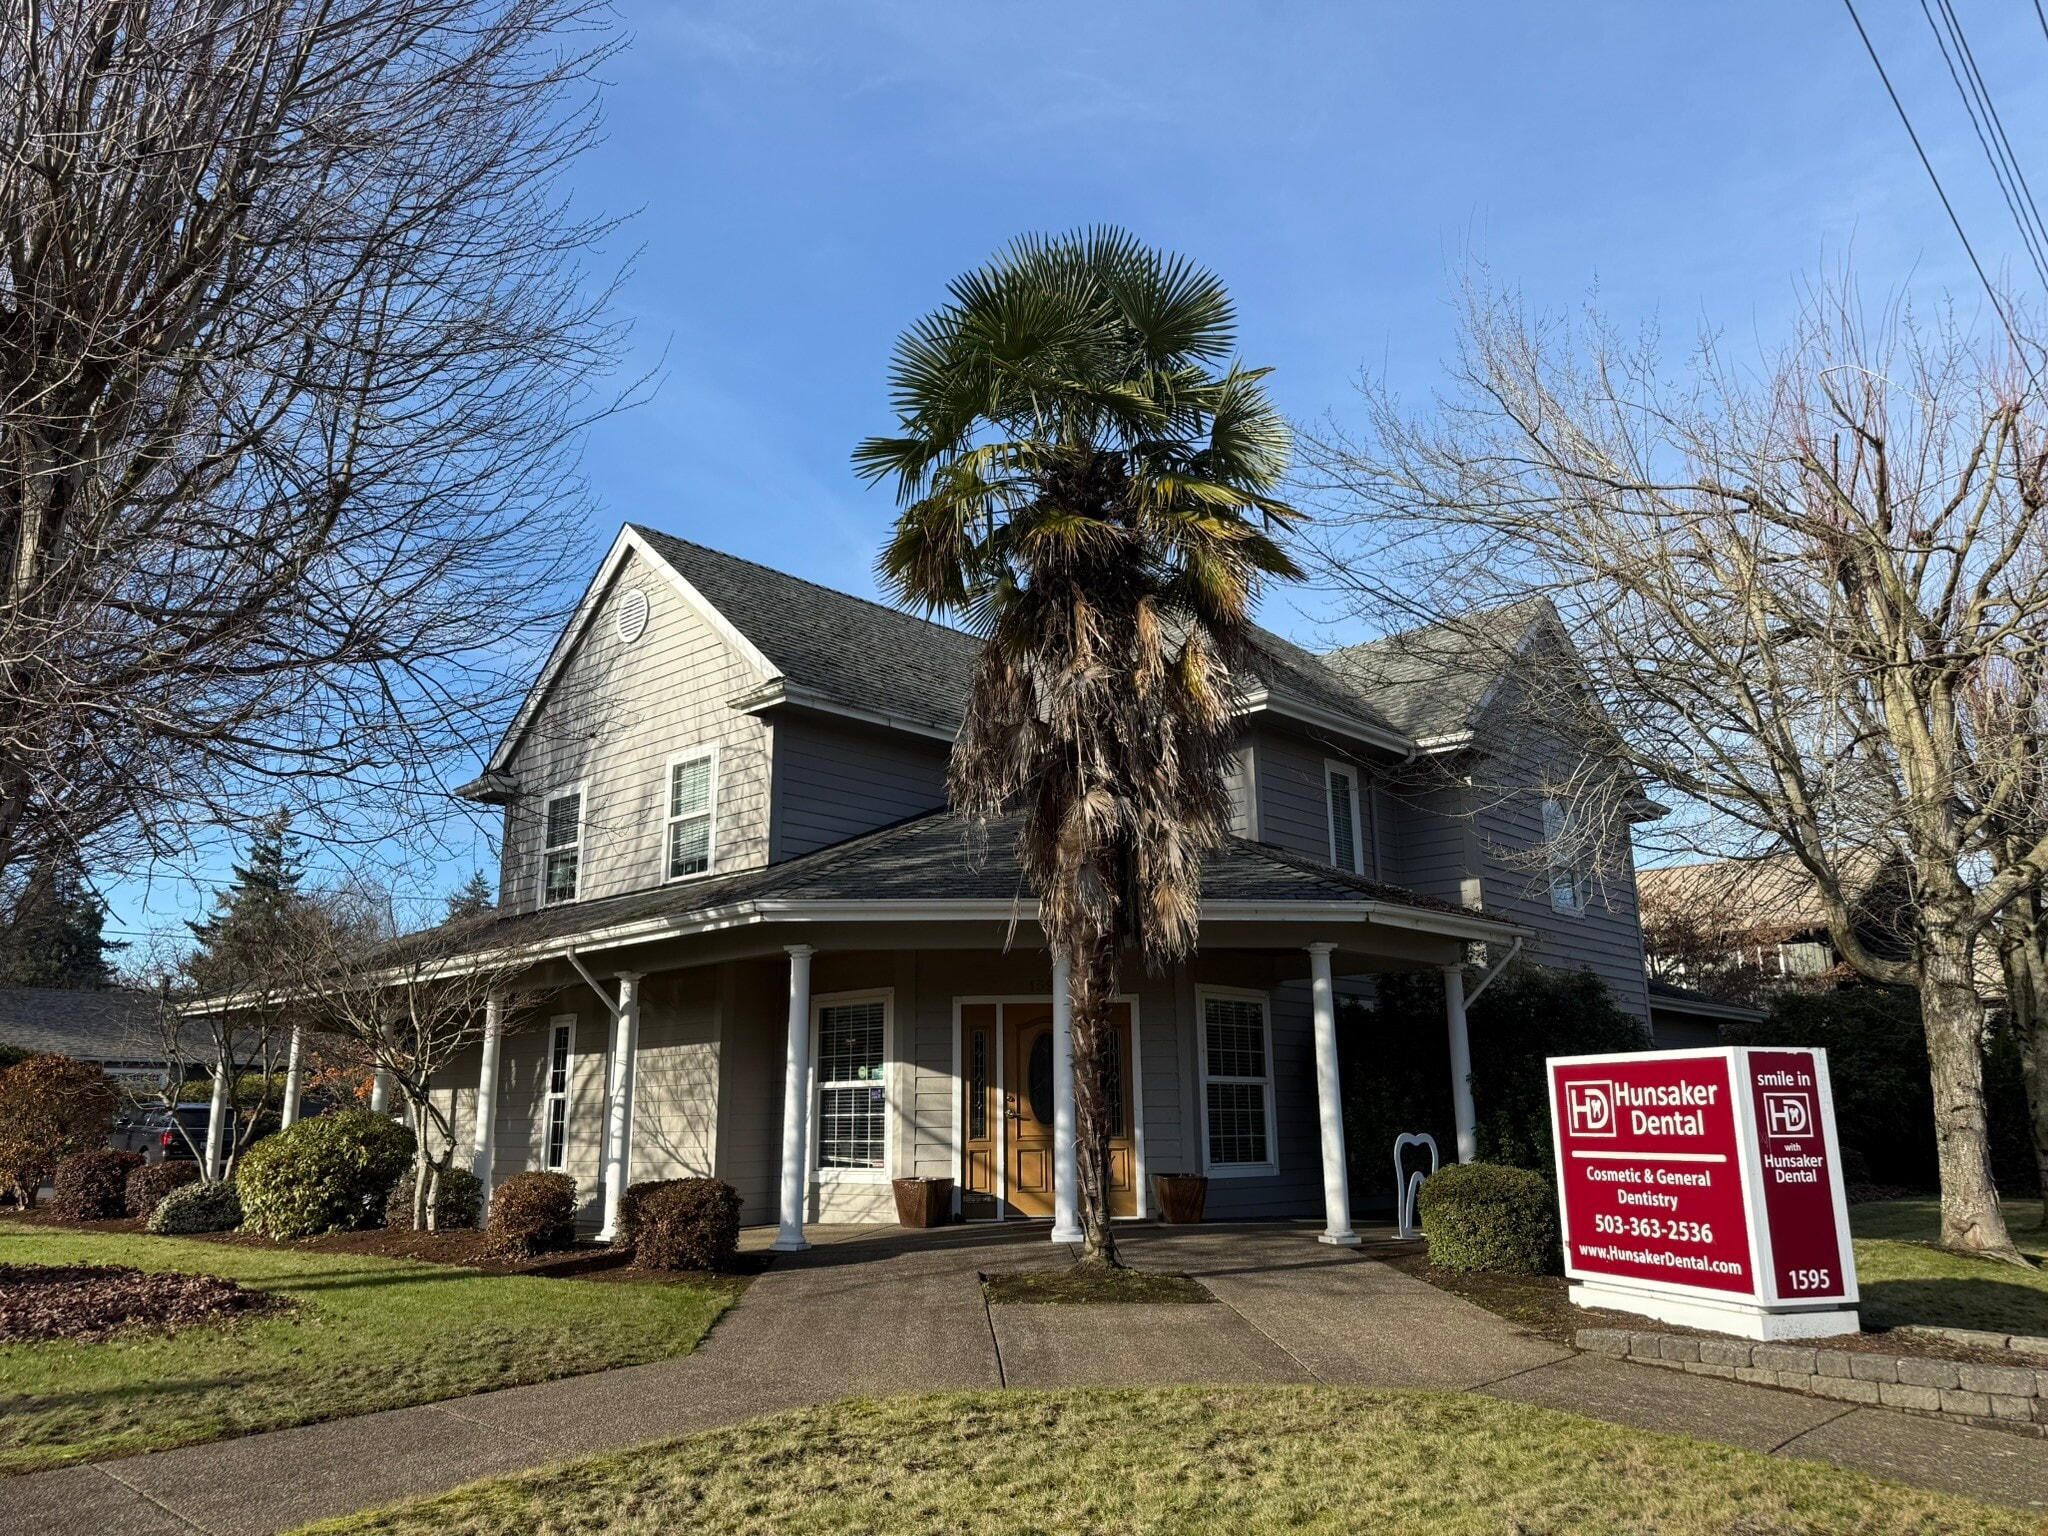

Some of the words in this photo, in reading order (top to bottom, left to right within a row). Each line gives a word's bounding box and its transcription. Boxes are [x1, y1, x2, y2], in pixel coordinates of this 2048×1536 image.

[1757, 1071, 1795, 1086] smile
[1797, 1071, 1811, 1086] in
[1615, 1080, 1718, 1107] Hunsaker
[1632, 1109, 1705, 1136] Dental
[1784, 1142, 1802, 1152] with
[1764, 1154, 1824, 1168] Hunsaker
[1586, 1166, 1642, 1184] Cosmetic
[1644, 1168, 1654, 1184] &
[1656, 1169, 1712, 1187] General
[1775, 1169, 1818, 1183] Dental
[1617, 1189, 1678, 1211] Dentistry
[1595, 1214, 1714, 1244] 503-363-2536
[1579, 1244, 1743, 1275] www.HunsakerDental.com
[1788, 1269, 1830, 1290] 1595
